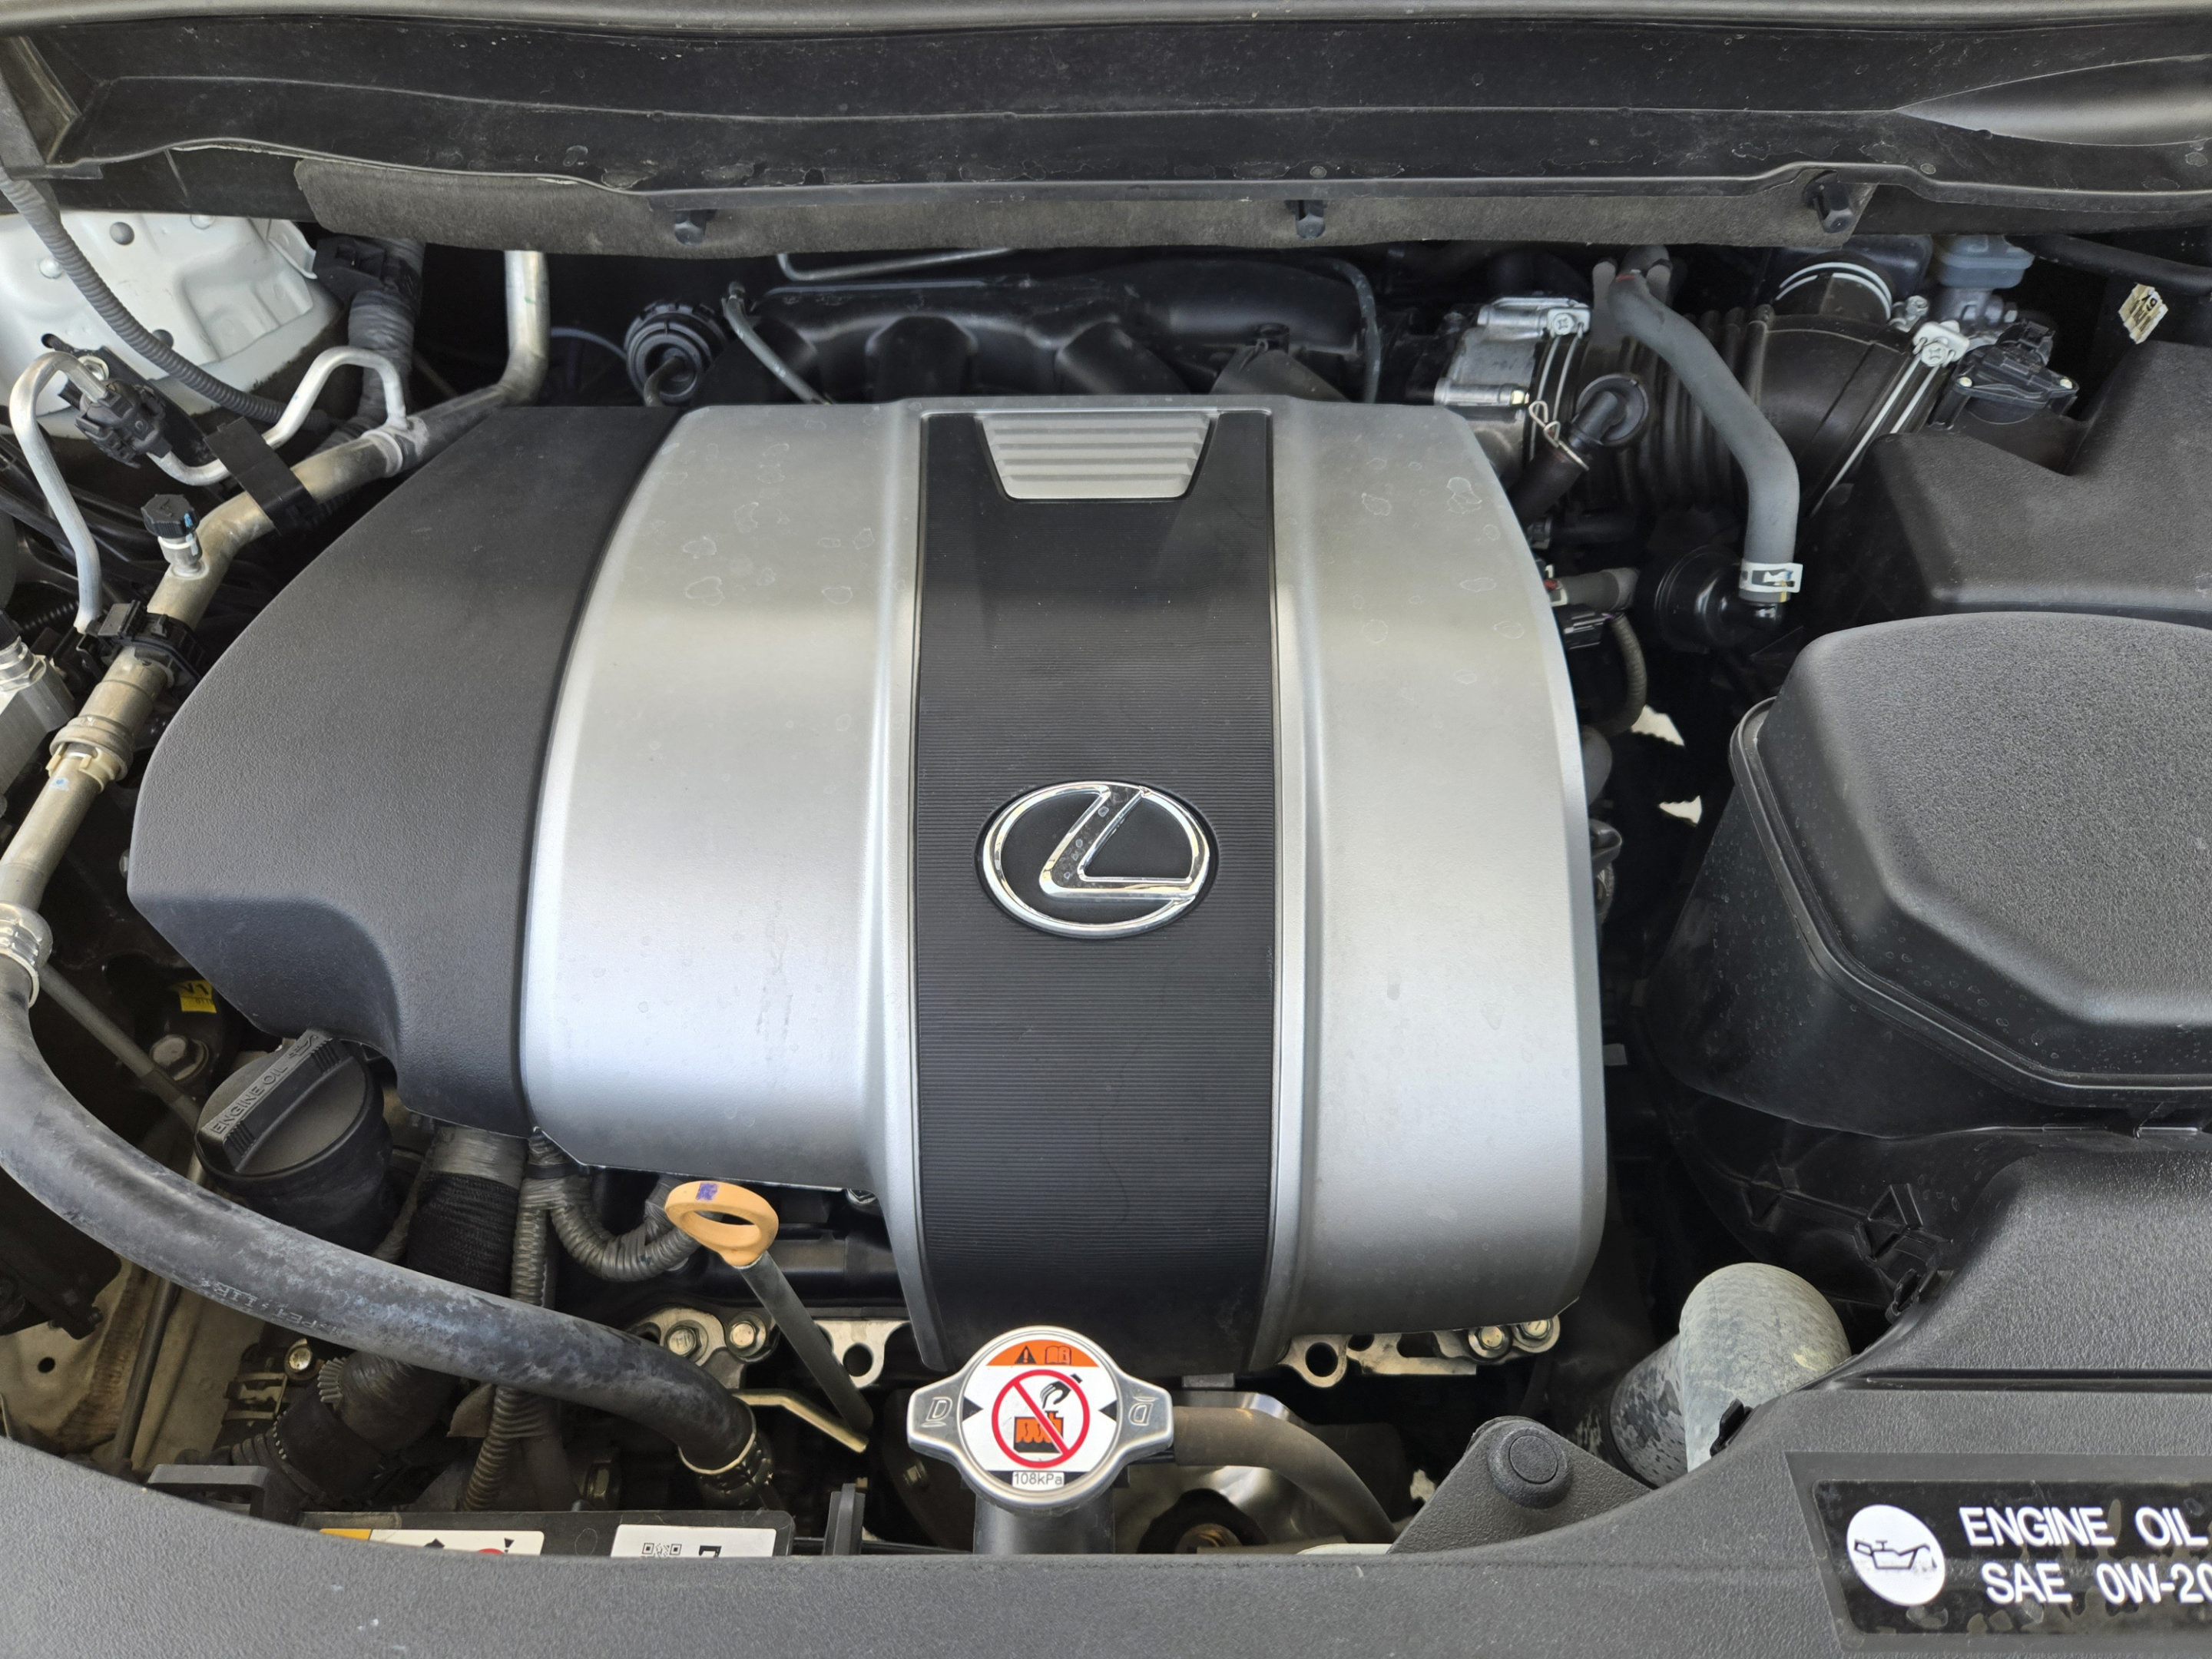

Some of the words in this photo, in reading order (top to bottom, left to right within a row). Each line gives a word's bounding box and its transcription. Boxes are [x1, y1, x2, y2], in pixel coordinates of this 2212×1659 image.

[210, 1084, 265, 1135] ENGINE
[263, 1065, 289, 1086] OIL
[1012, 1472, 1065, 1486] 108kPa
[1958, 1506, 2118, 1547] ENGINE
[2134, 1506, 2210, 1548] OIL
[1982, 1562, 2073, 1604] SAE
